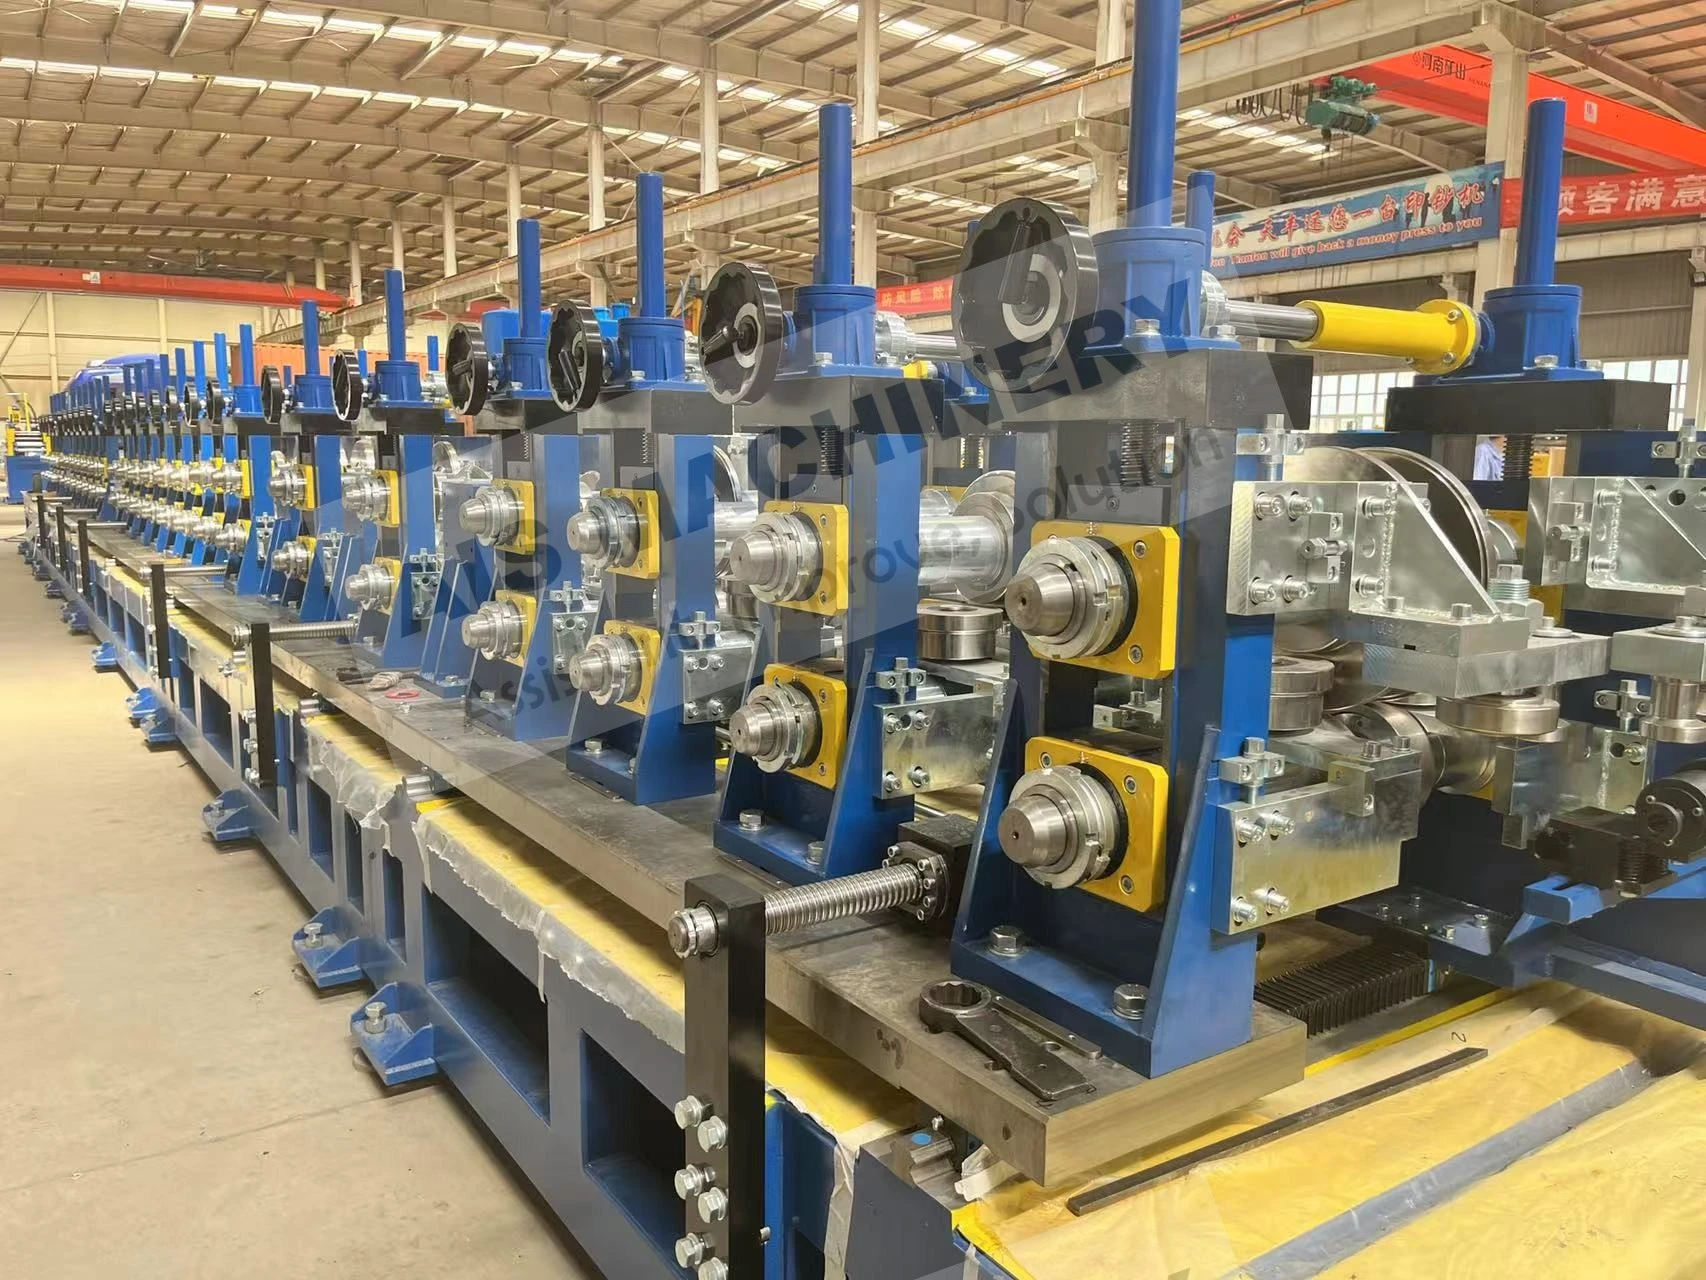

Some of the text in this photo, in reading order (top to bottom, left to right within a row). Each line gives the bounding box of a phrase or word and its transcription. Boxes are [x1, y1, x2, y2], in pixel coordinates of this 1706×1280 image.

[1270, 246, 1290, 260] will
[1292, 244, 1316, 259] give
[1317, 237, 1345, 253] back
[1356, 230, 1400, 247] money
[1400, 224, 1437, 242] press
[1438, 221, 1454, 234] to
[1455, 216, 1483, 233] you
